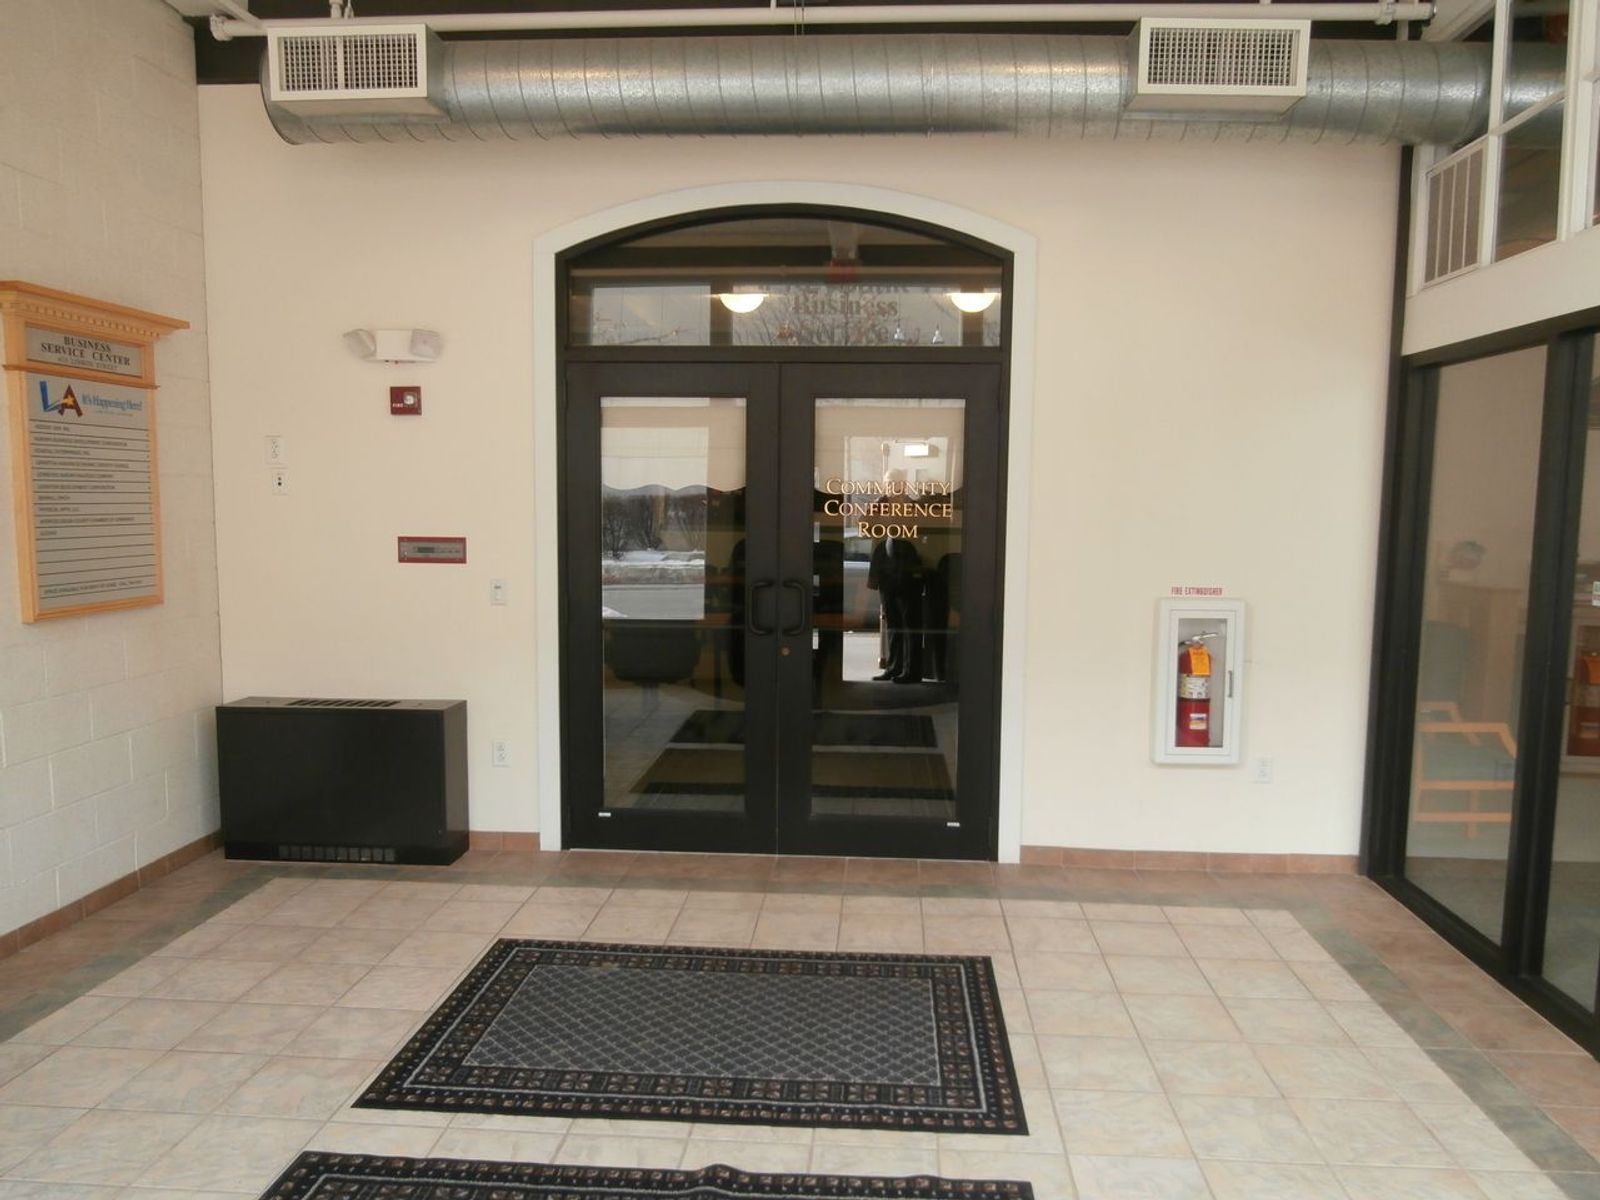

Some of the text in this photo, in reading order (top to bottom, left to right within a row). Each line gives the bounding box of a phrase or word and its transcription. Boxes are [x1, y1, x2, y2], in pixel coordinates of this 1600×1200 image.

[63, 336, 112, 353] BUSINESS
[41, 343, 130, 366] SERVICE CENTER
[39, 380, 83, 417] LA
[826, 478, 951, 496] COMMUNITY
[823, 499, 953, 518] CONFERENCE
[857, 521, 919, 539] ROOM
